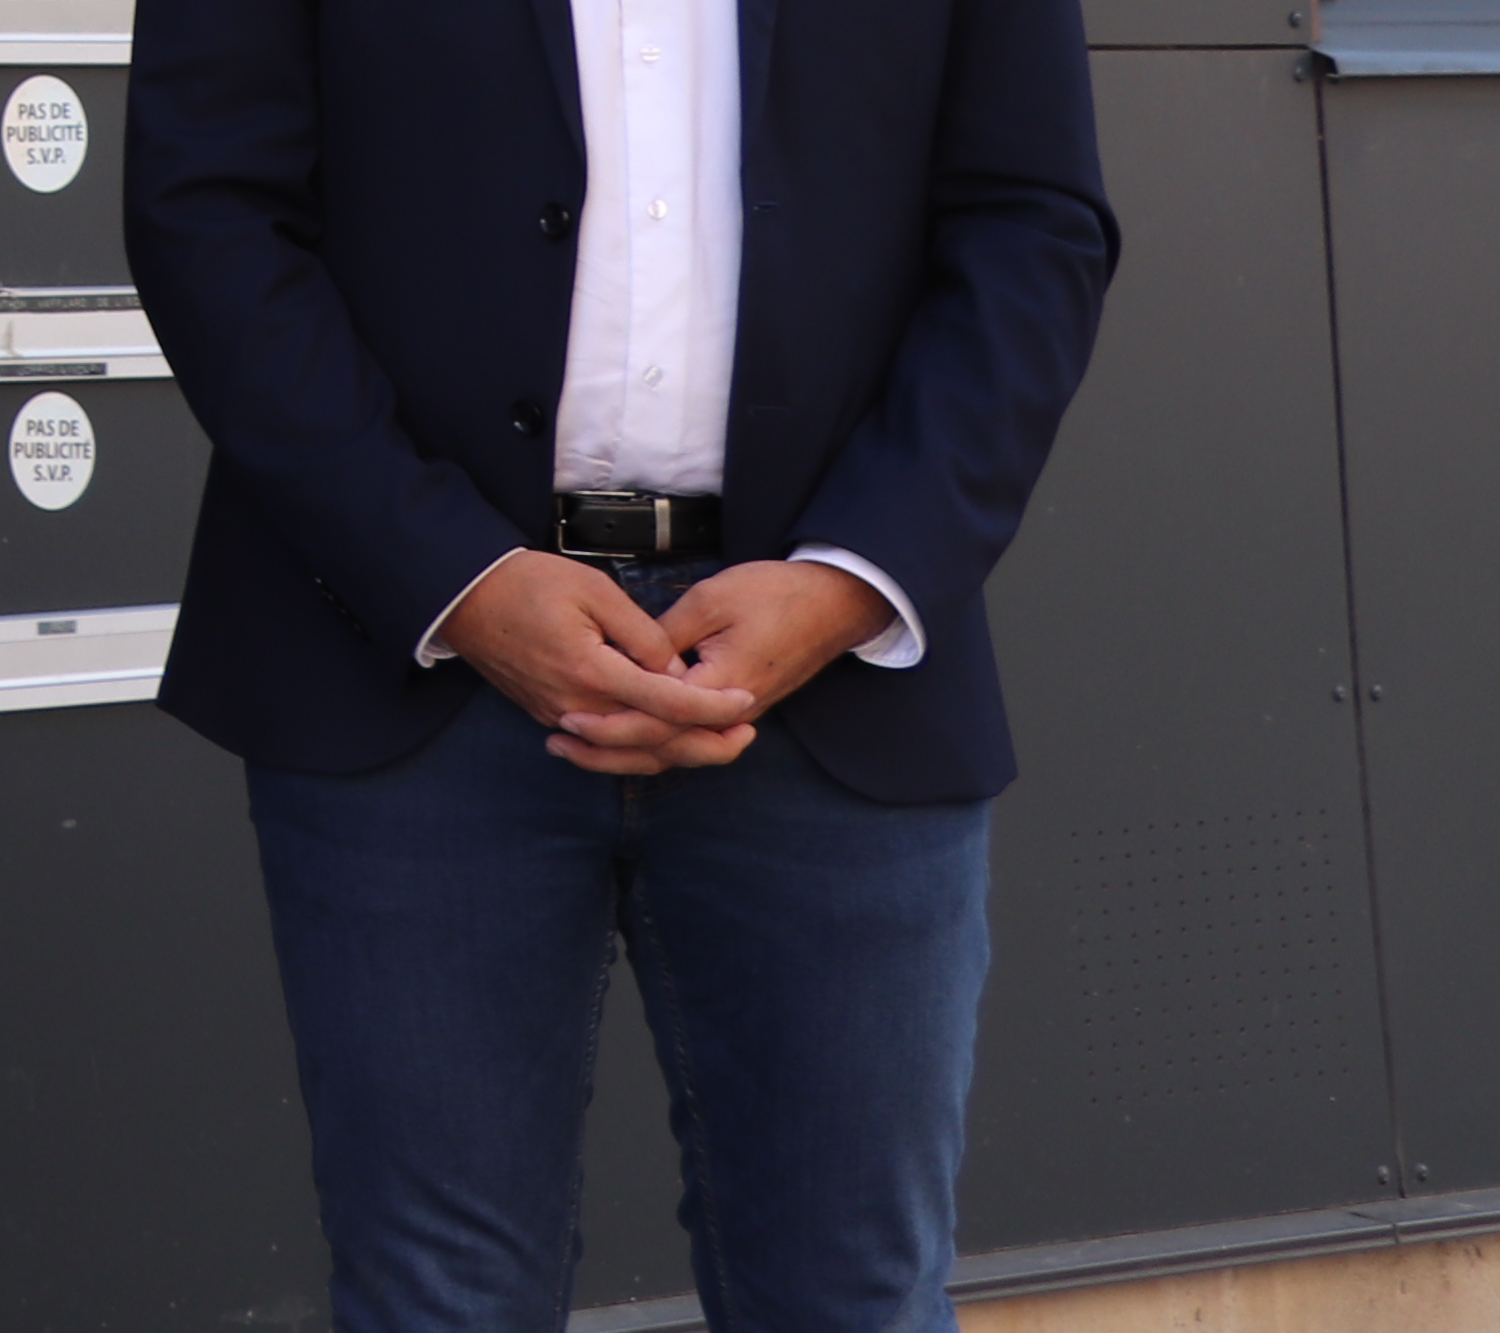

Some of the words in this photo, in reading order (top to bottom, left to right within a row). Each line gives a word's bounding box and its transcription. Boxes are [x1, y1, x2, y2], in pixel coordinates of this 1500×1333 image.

[18, 102, 47, 120] PAS
[50, 102, 71, 120] DE
[6, 120, 85, 142] PUBLICITÉ
[26, 146, 67, 165] S.V.P.
[26, 419, 56, 437] PAS
[58, 419, 80, 437] DE
[13, 438, 92, 460] PUBLICITÉ
[33, 463, 74, 482] S.V.P.
